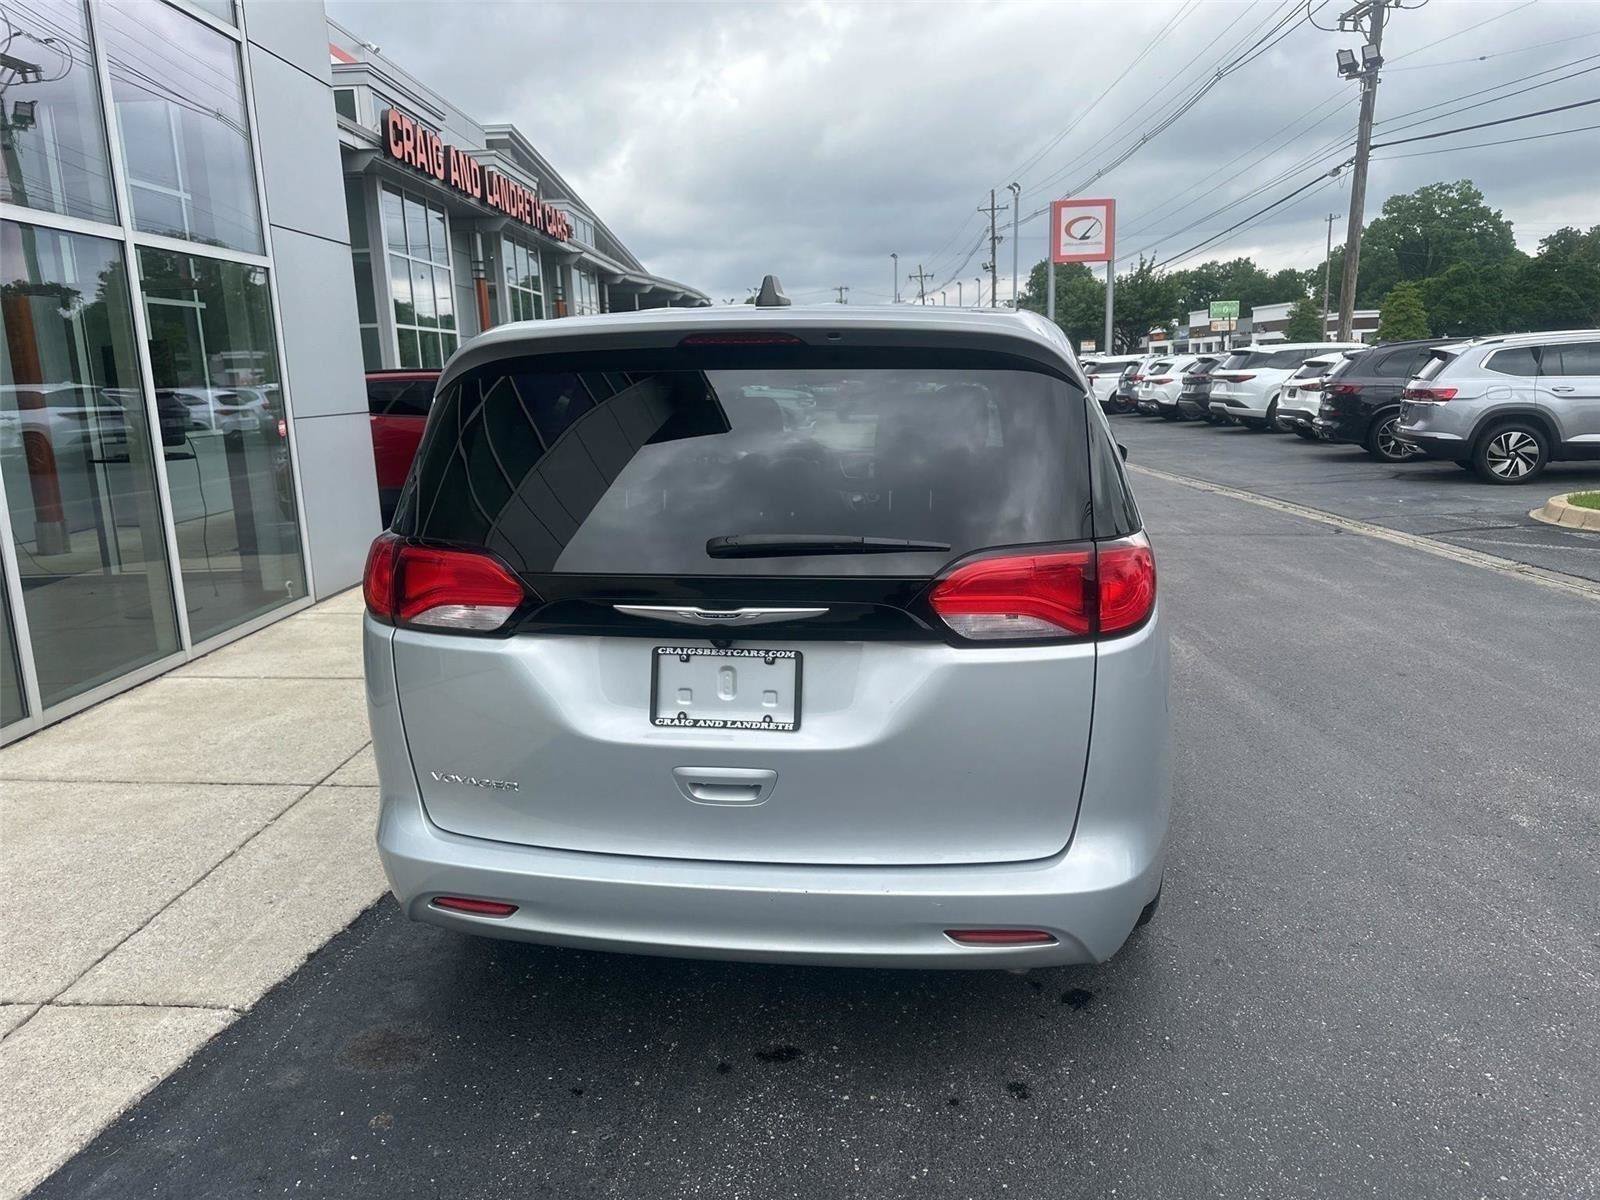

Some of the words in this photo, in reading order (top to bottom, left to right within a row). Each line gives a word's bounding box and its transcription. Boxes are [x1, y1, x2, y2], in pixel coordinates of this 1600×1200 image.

[388, 108, 445, 181] CRAIG
[450, 145, 482, 199] AND
[485, 165, 544, 230] LANDRETH
[545, 203, 568, 242] CARS
[657, 647, 796, 659] CRAIGSBESTCARS.COM
[655, 718, 694, 727] CRAIG
[696, 719, 724, 728] AND
[726, 721, 794, 731] LANDRETH
[431, 771, 519, 792] VOYAGER
